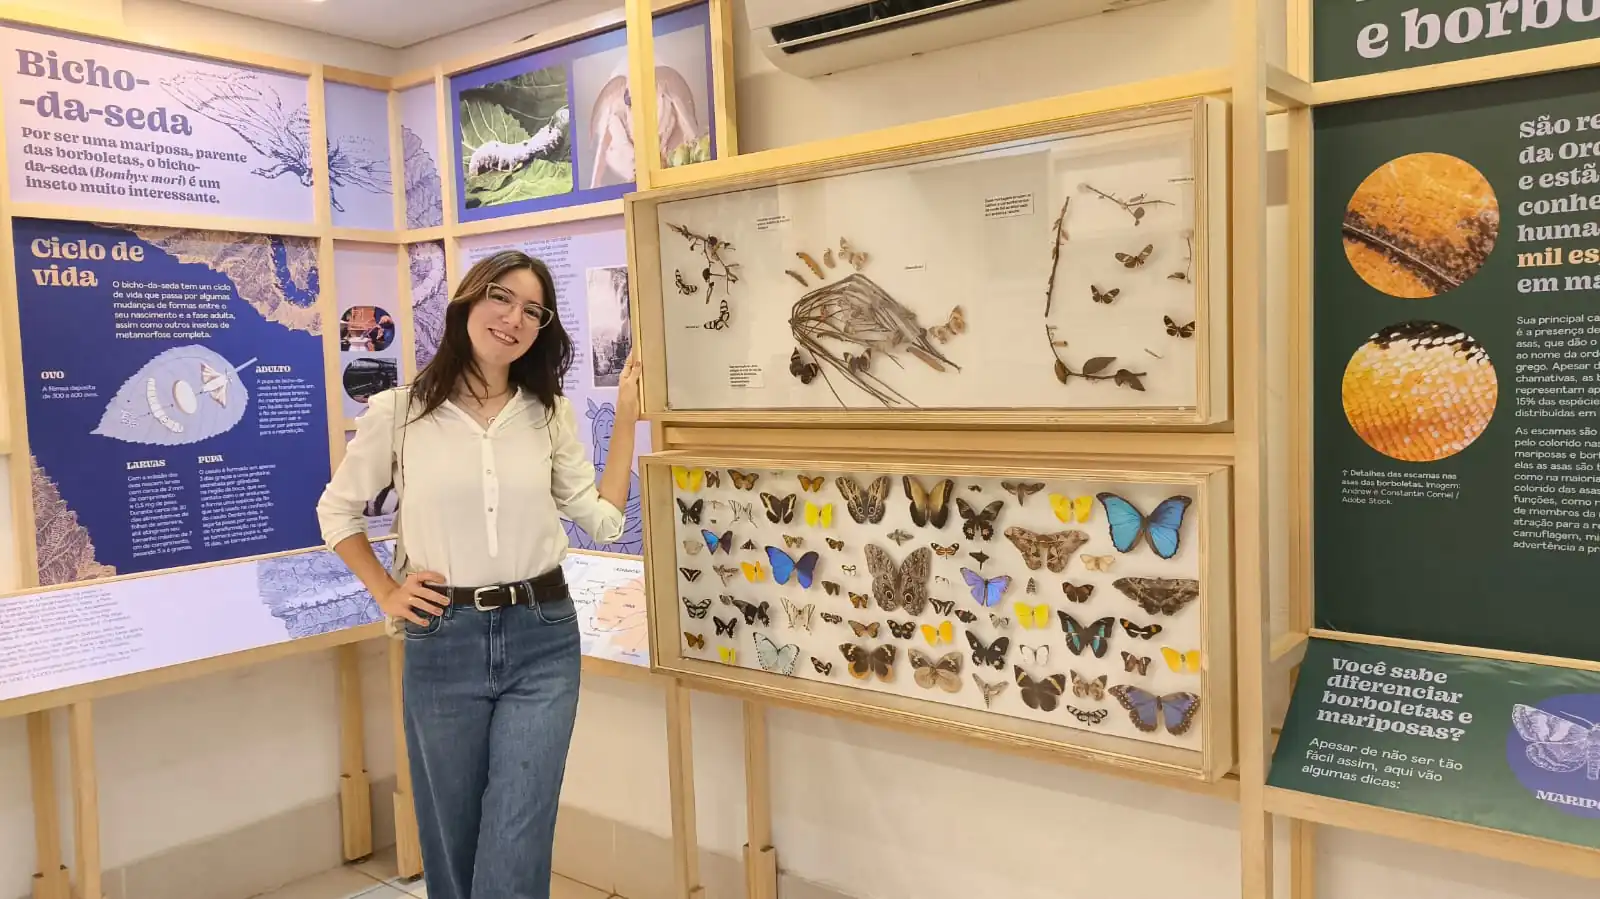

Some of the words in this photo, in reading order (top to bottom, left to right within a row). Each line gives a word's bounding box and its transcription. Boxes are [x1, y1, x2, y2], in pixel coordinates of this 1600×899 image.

[1357, 22, 1389, 59] e
[16, 49, 150, 92] Bicho-
[20, 92, 192, 136] -da-seda
[1520, 115, 1571, 139] São
[22, 127, 51, 141] Por
[54, 132, 79, 144] ser
[82, 135, 118, 149] uma
[120, 138, 193, 159] mariposa,
[196, 148, 247, 163] parente
[23, 143, 53, 157] das
[55, 146, 144, 169] borboletas,
[147, 158, 155, 169] o
[157, 157, 200, 172] bicho-
[1519, 146, 1554, 164] da
[24, 160, 88, 177] da-seda
[90, 166, 147, 185] (Bombyx
[151, 172, 186, 187] mori)
[189, 174, 196, 187] é
[199, 179, 220, 190] um
[1519, 176, 1534, 190] e
[1539, 163, 1600, 188] estã
[26, 176, 77, 192] inseto
[80, 181, 126, 196] muito
[129, 185, 220, 204] interessante.
[1518, 193, 1600, 216] conhe
[1517, 222, 1600, 242] huma
[31, 237, 106, 260] Ciclo
[112, 241, 145, 262] de
[1517, 247, 1563, 268] mil
[32, 265, 98, 287] vida
[122, 281, 180, 290] bicho-da-seda
[213, 283, 231, 291] ciclo
[1517, 277, 1559, 293] em
[126, 291, 142, 299] vida
[145, 292, 159, 300] que
[200, 294, 230, 302] algumas
[114, 301, 155, 310] mudanças
[169, 301, 197, 309] formas
[210, 312, 236, 320] adulta,
[1517, 317, 1536, 325] Sua
[1539, 314, 1584, 325] principal
[116, 331, 171, 339] metamorfose
[173, 331, 211, 339] completa.
[1516, 328, 1522, 336] é
[1535, 328, 1584, 338] presença
[1544, 340, 1564, 349] que
[1568, 338, 1588, 347] dão
[1564, 350, 1577, 358] da
[1516, 364, 1548, 373] grego.
[1552, 362, 1591, 372] Apesar
[41, 371, 65, 379] OVO
[1516, 374, 1578, 383] chamativas,
[1516, 386, 1585, 396] representam
[1517, 398, 1536, 406] 15%
[1539, 397, 1556, 406] das
[1515, 409, 1575, 417] distribuídas
[1515, 427, 1528, 435] As
[1579, 426, 1598, 436] são
[1515, 439, 1536, 449] pelo
[1539, 439, 1581, 447] colorido
[198, 455, 224, 464] PUPA
[1515, 451, 1567, 460] mariposas
[126, 460, 166, 470] LARVAS
[1515, 461, 1534, 469] elas
[1551, 463, 1572, 471] asas
[1576, 462, 1593, 471] são
[1514, 473, 1543, 481] como
[1377, 480, 1424, 488] borboletas.
[1426, 482, 1461, 490] Imagem:
[1514, 484, 1555, 493] colorido
[1558, 485, 1576, 494] das
[1381, 489, 1424, 497] Constantin
[1514, 495, 1557, 506] funções,
[1562, 498, 1591, 506] como
[1513, 507, 1526, 515] de
[1529, 508, 1580, 517] membros
[1583, 509, 1595, 518] da
[1513, 518, 1554, 528] atração
[1556, 521, 1580, 529] para
[1513, 529, 1581, 542] camuflagem,
[1513, 540, 1576, 552] advertência
[1332, 658, 1387, 676] Você
[1390, 667, 1448, 684] sabe
[1327, 675, 1464, 704] diferenciar
[1322, 691, 1454, 722] borboletas
[1459, 712, 1473, 724] e
[1316, 710, 1466, 742] mariposas?
[1309, 738, 1357, 753] Apesar
[1361, 746, 1378, 757] de
[1381, 749, 1407, 762] não
[1411, 755, 1435, 765] ser
[1439, 758, 1463, 771] tão
[1306, 750, 1334, 764] fácil
[1337, 756, 1378, 773] assim,
[1384, 765, 1413, 778] aqui
[1418, 769, 1443, 782] vão
[1302, 764, 1357, 782] algumas
[1360, 774, 1401, 789] dicas:
